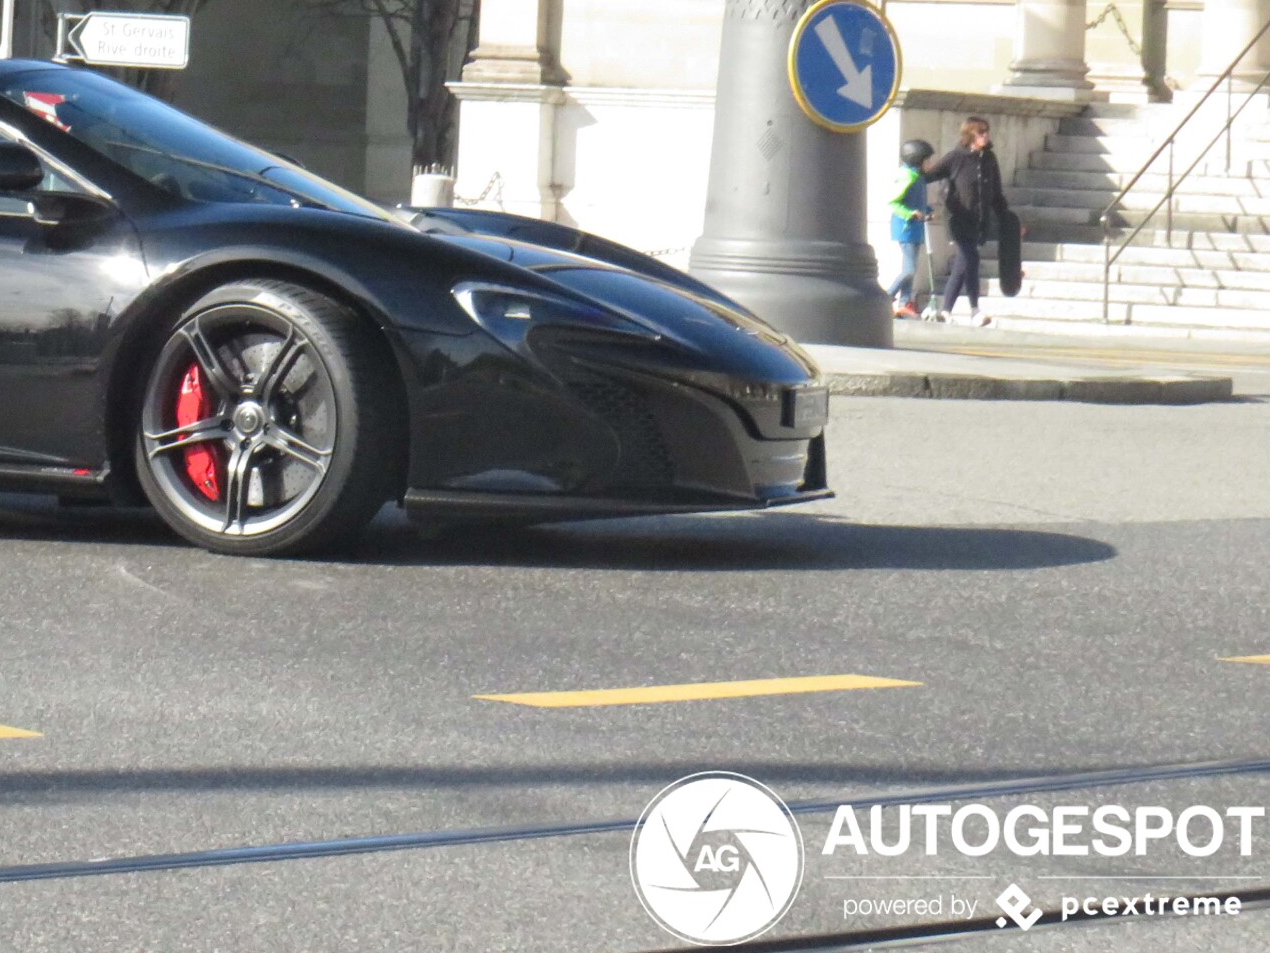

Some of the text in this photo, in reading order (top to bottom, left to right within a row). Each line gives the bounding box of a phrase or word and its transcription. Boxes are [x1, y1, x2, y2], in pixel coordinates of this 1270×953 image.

[102, 21, 175, 40] St Gervais
[98, 40, 176, 59] Rive droite
